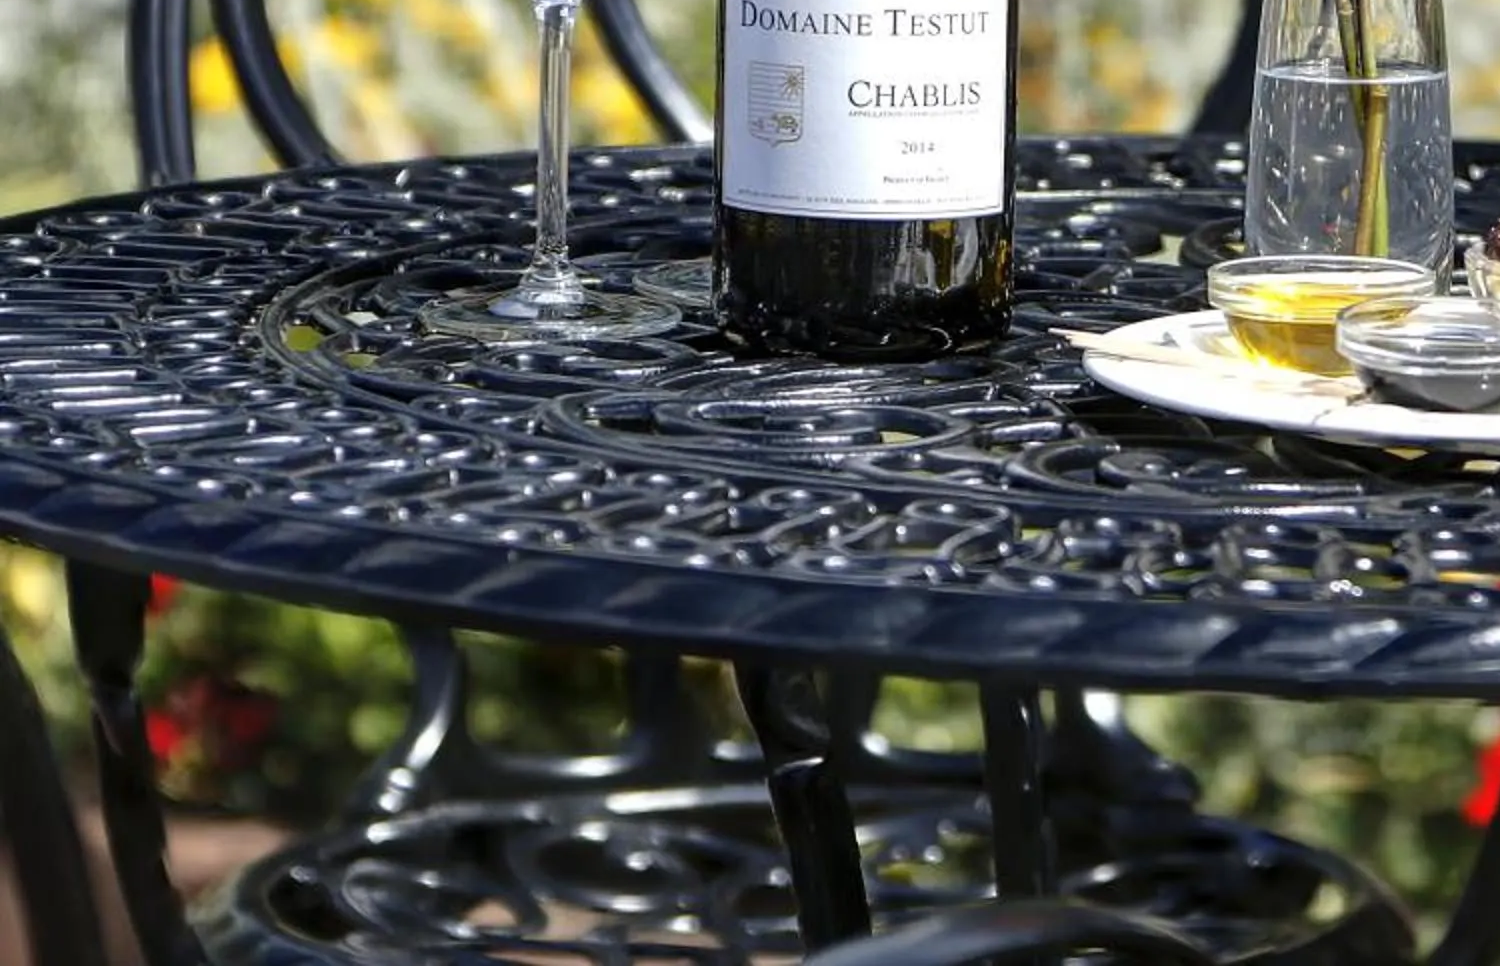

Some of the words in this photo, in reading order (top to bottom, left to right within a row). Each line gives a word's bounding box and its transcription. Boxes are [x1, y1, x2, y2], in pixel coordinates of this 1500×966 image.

[741, 0, 873, 37] DOMAINE
[884, 8, 990, 37] TESTUT
[847, 80, 981, 108] CHABLIS
[901, 140, 935, 155] 2014
